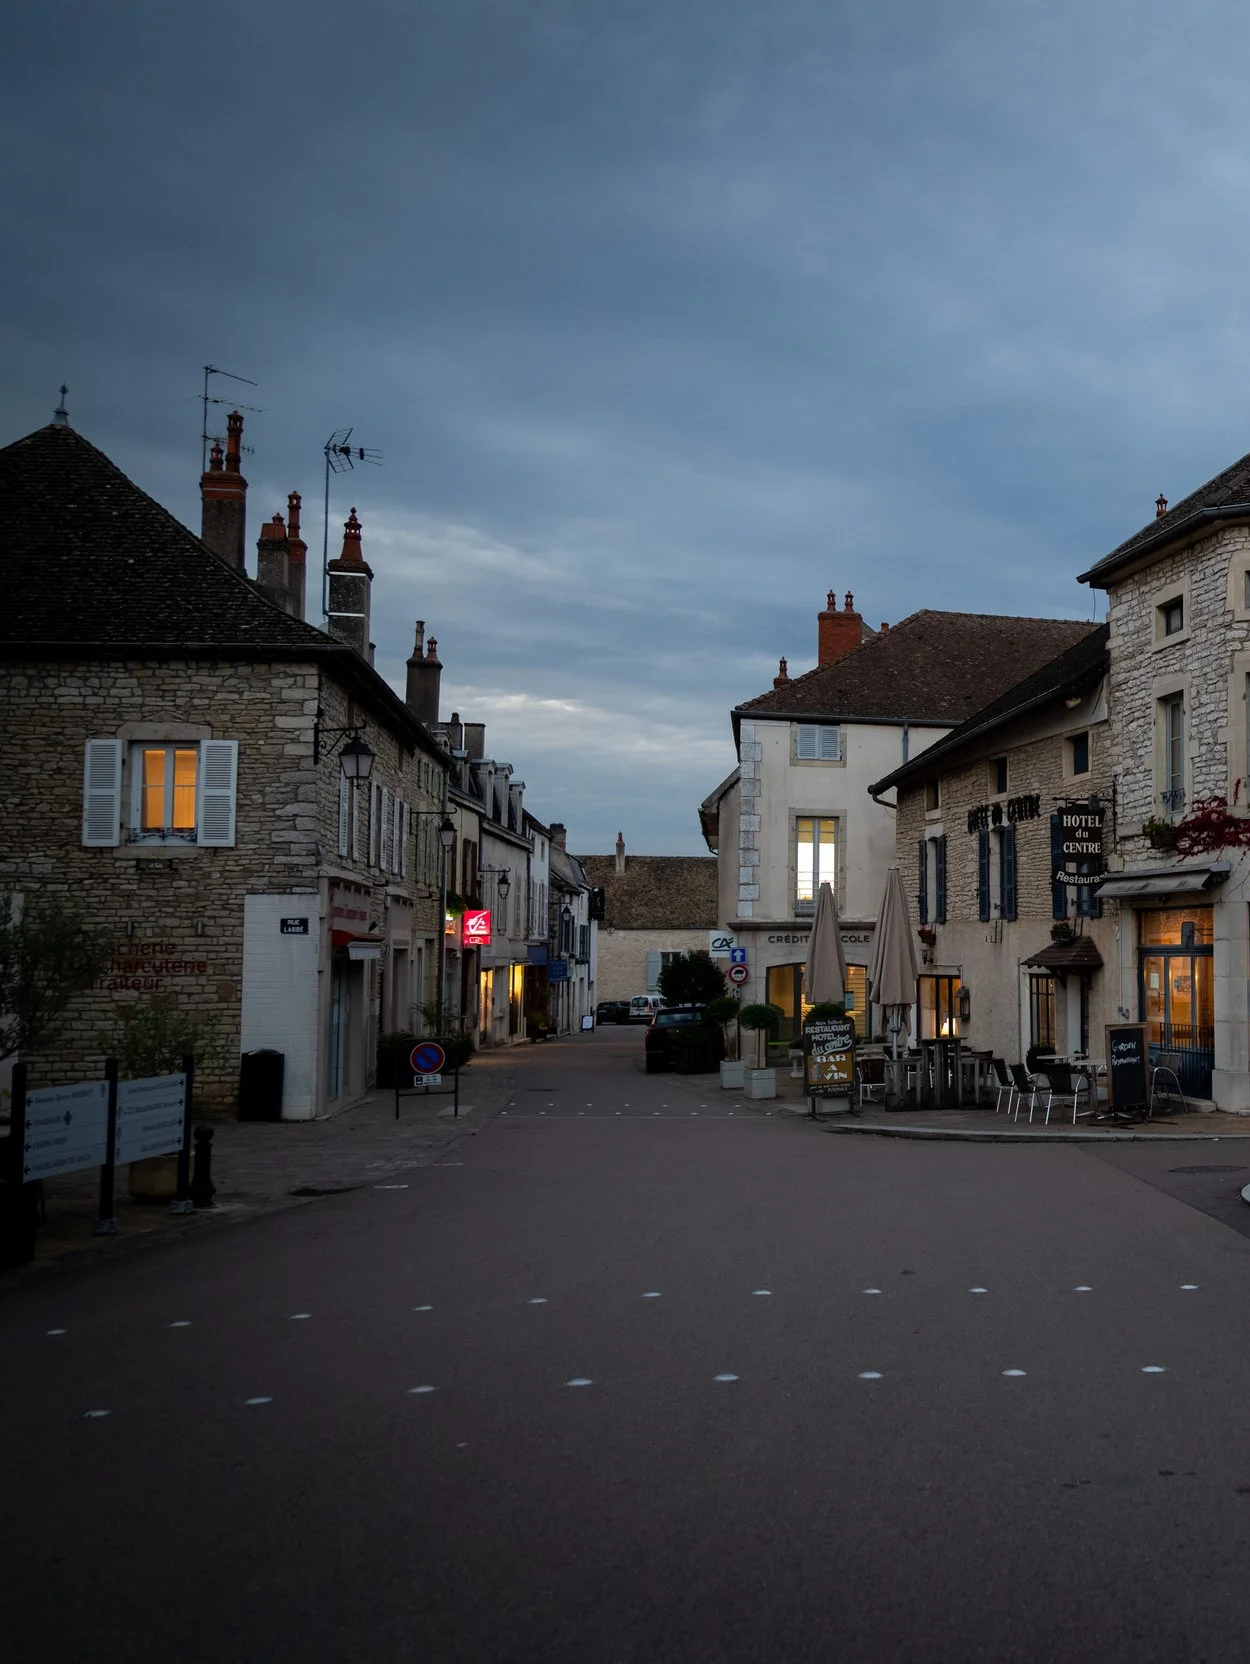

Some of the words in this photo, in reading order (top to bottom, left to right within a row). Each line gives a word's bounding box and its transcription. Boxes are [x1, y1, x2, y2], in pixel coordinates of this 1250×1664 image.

[1063, 815, 1102, 828] HOTEL
[1075, 828, 1089, 838] du
[1063, 842, 1101, 854] CENTRE
[768, 933, 810, 943] CRÉDIT
[841, 935, 870, 943] COLE
[103, 957, 207, 973] harcuterie
[805, 1024, 851, 1034] RESTAURANT
[811, 1033, 836, 1042] HOTEL
[811, 1042, 824, 1056] du
[816, 1054, 847, 1063] BAR
[824, 1072, 848, 1080] VIN
